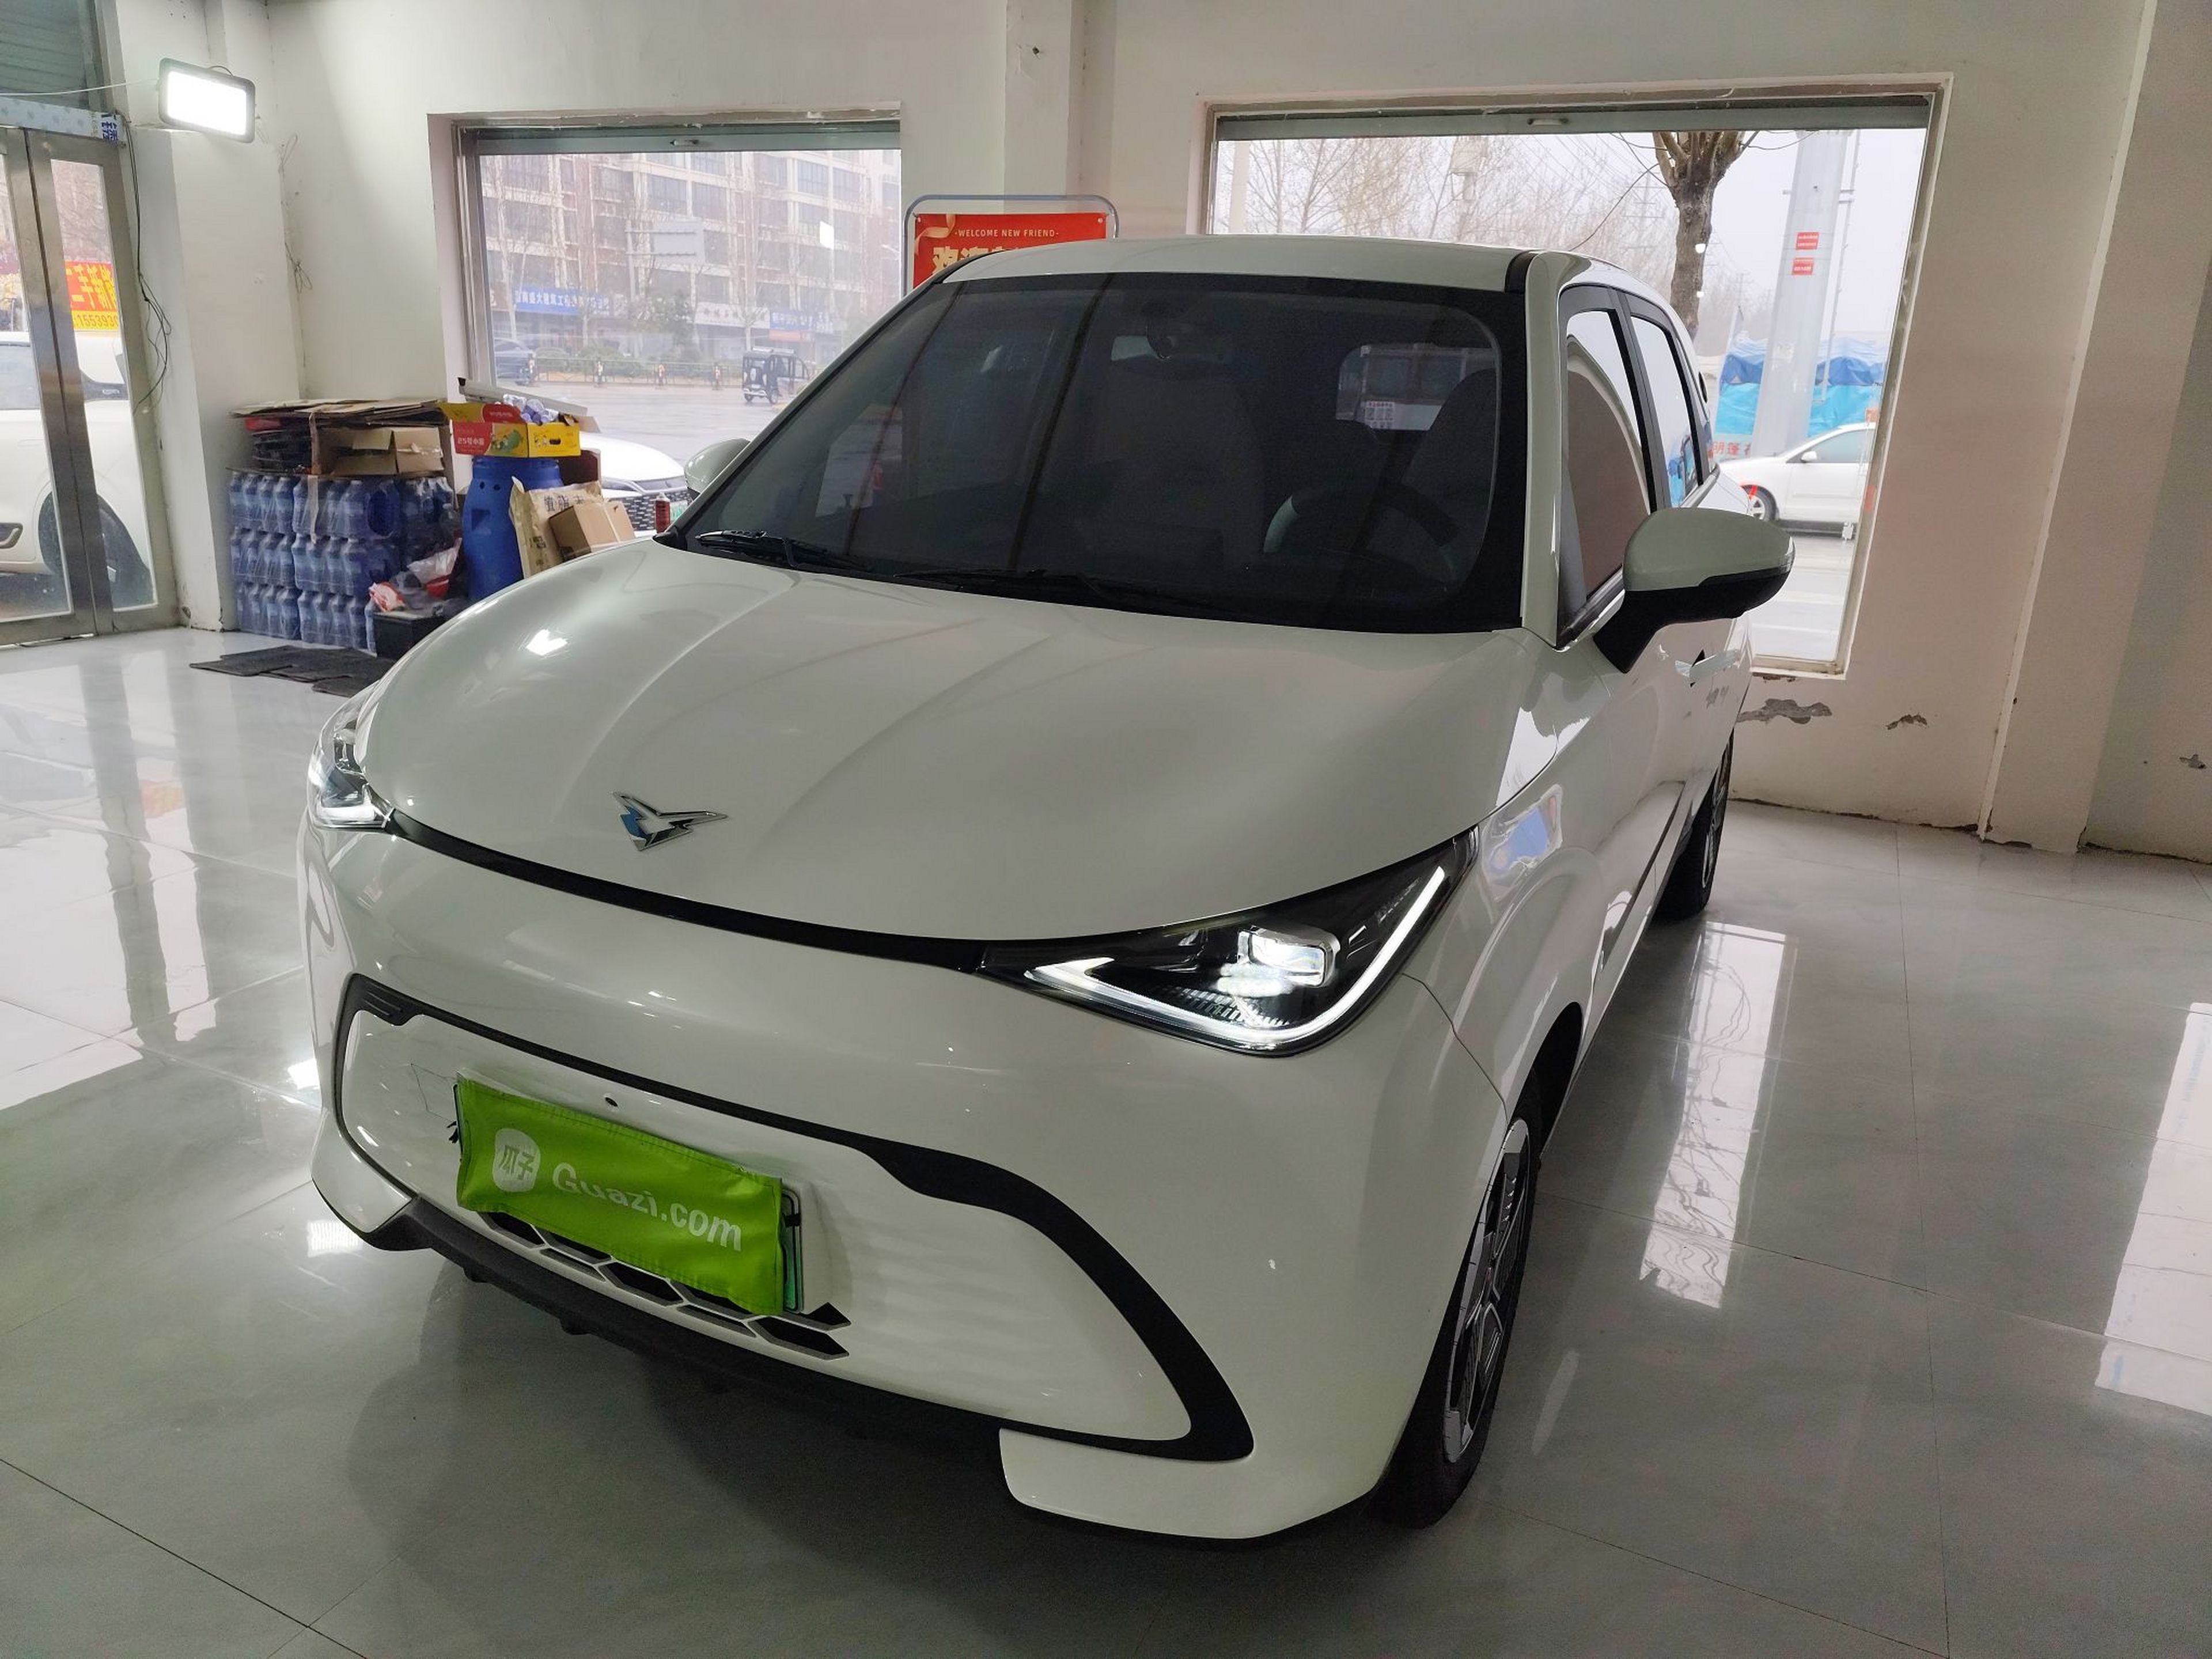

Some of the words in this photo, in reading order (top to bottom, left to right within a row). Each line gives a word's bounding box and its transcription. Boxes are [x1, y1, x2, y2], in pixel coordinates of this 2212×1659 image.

[1001, 229, 1021, 237] NEW
[500, 1144, 535, 1181] 瓜子
[552, 1162, 742, 1252] Guazi.com
